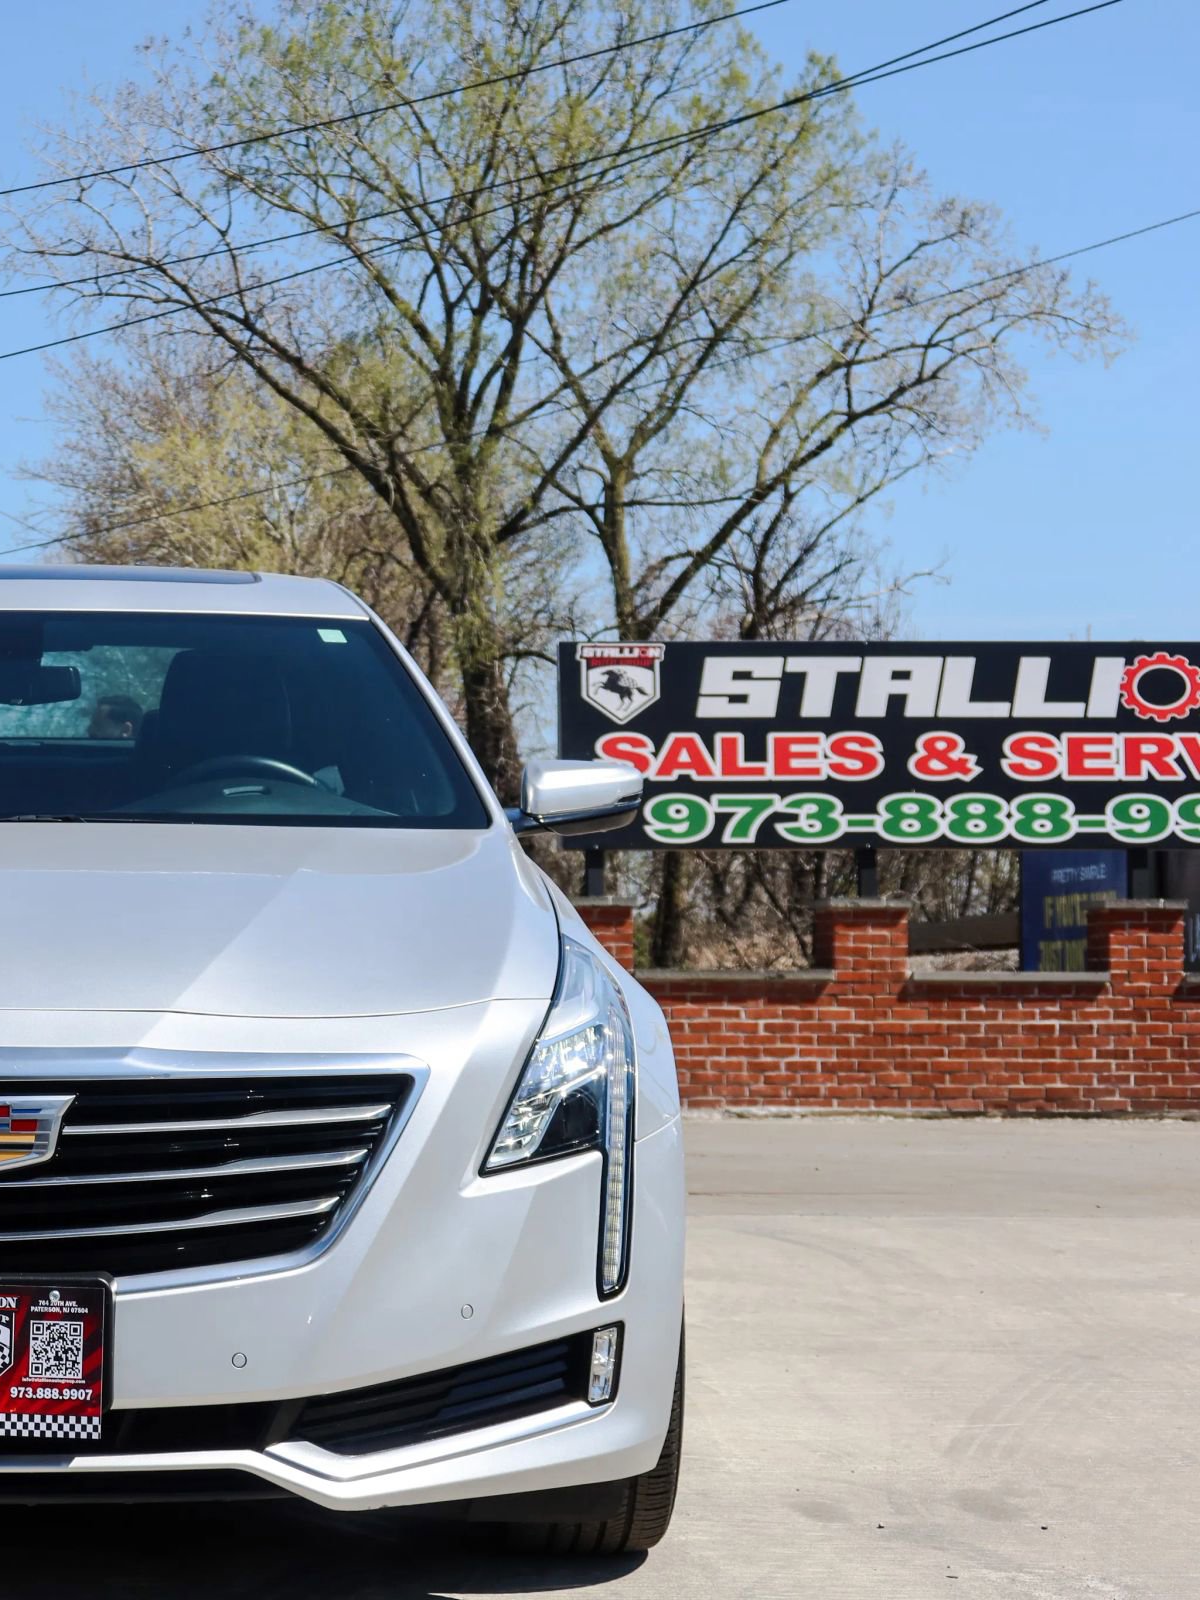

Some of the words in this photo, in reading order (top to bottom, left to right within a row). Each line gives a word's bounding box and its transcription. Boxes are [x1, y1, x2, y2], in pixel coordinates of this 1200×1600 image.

[581, 646, 661, 658] STALLION
[594, 732, 886, 781] SALES
[907, 731, 984, 782] &
[9, 1386, 93, 1401] 973.888.9907
